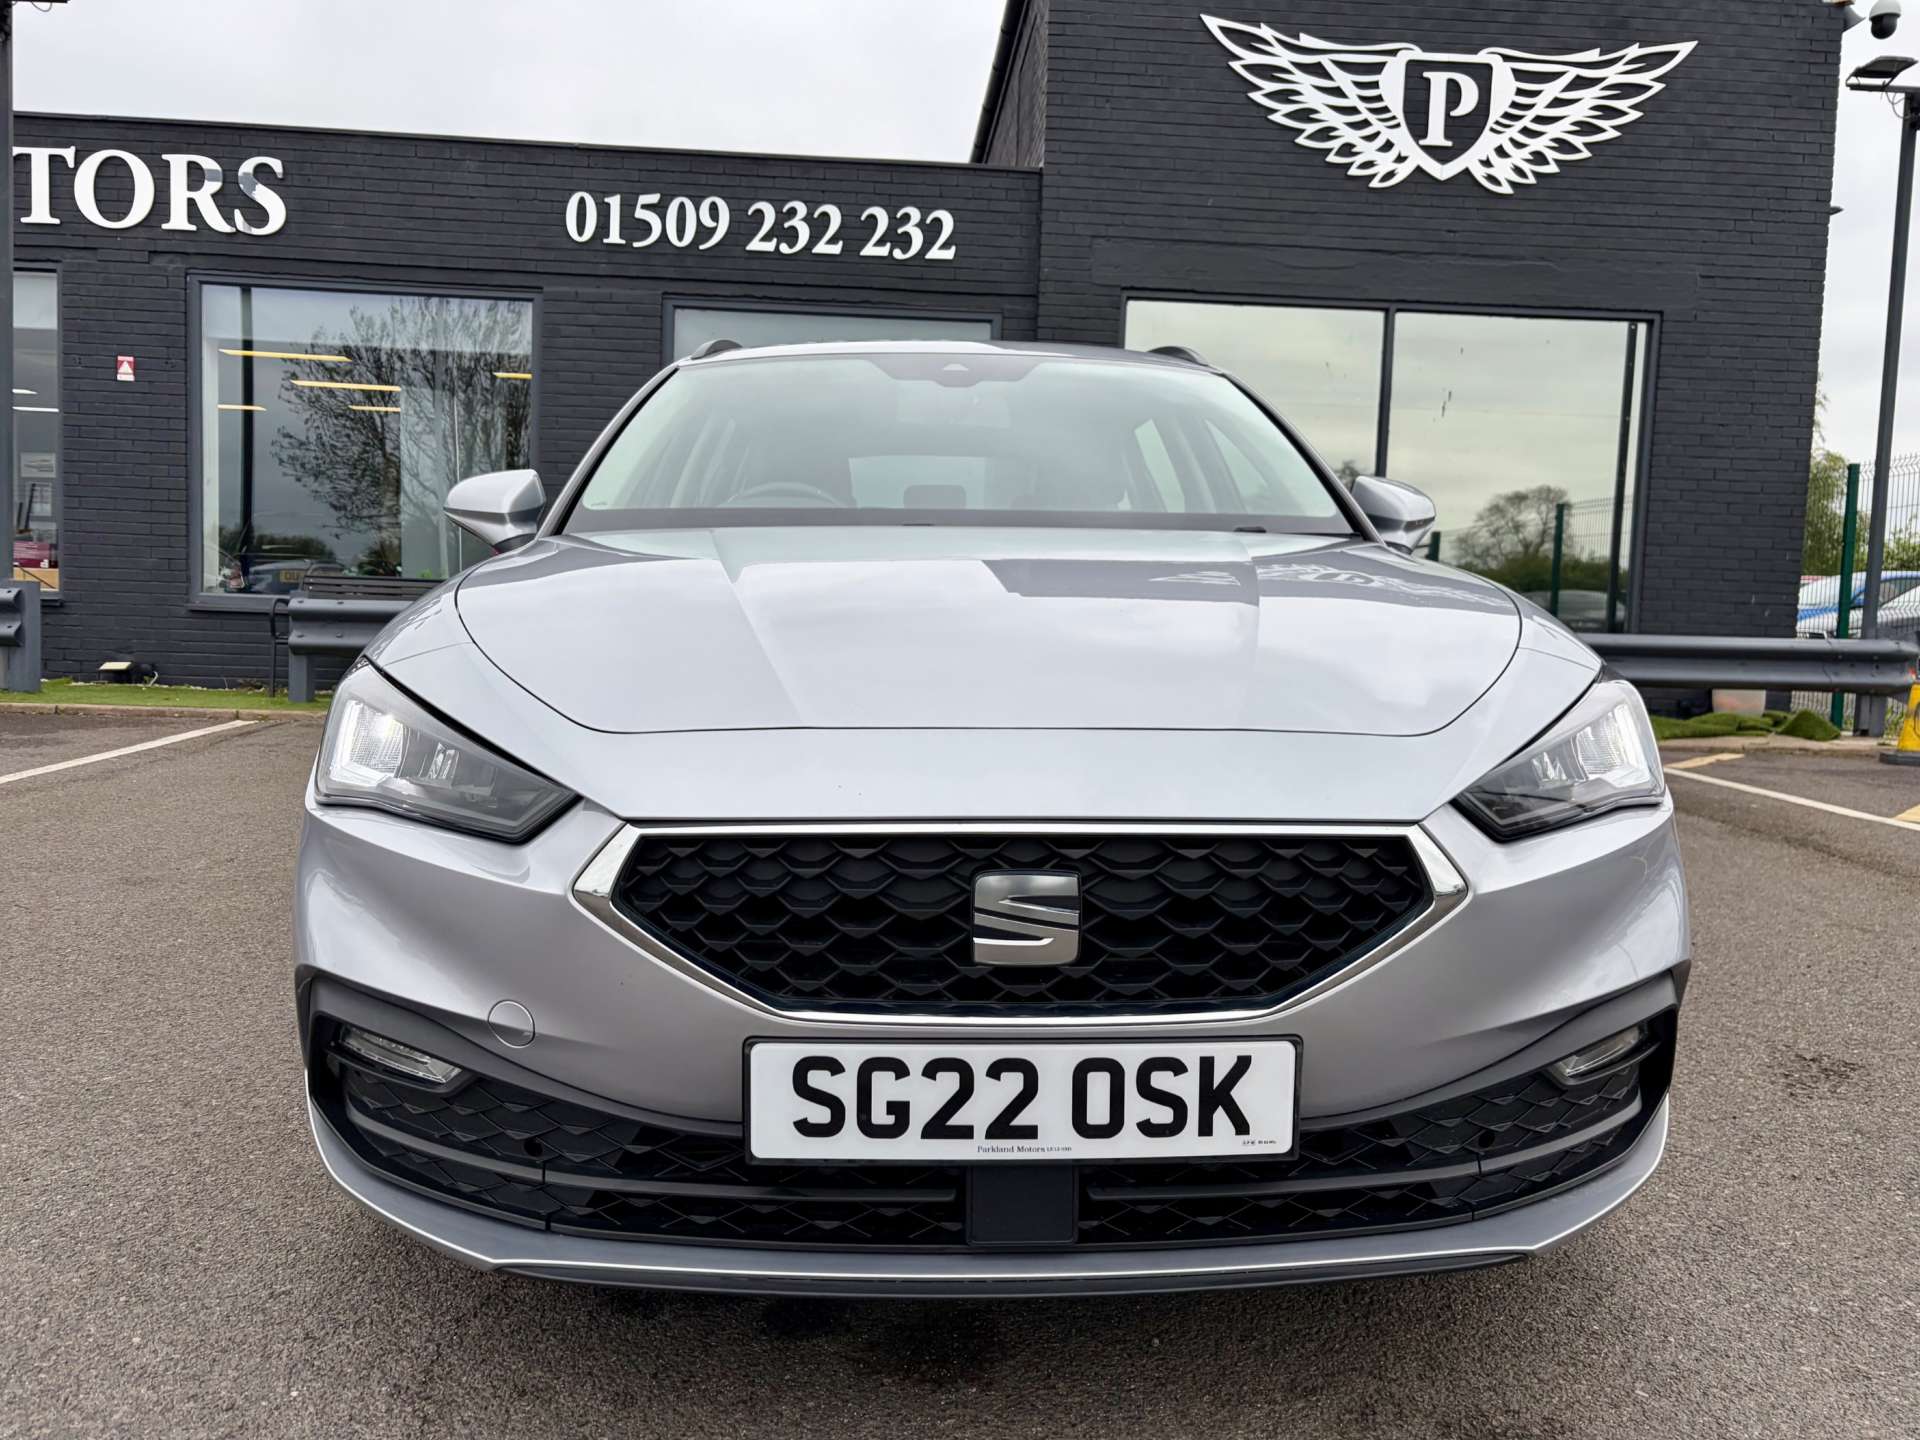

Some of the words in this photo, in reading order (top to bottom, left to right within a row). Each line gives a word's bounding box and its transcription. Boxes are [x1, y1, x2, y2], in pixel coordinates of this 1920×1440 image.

[1418, 71, 1479, 147] P
[565, 191, 730, 250] 01509
[745, 200, 844, 256] 232
[859, 205, 957, 261] 232
[792, 1055, 1039, 1140] SG22
[1071, 1054, 1252, 1140] OSK
[977, 1145, 1015, 1153] Parkland
[1016, 1145, 1046, 1153] Motors
